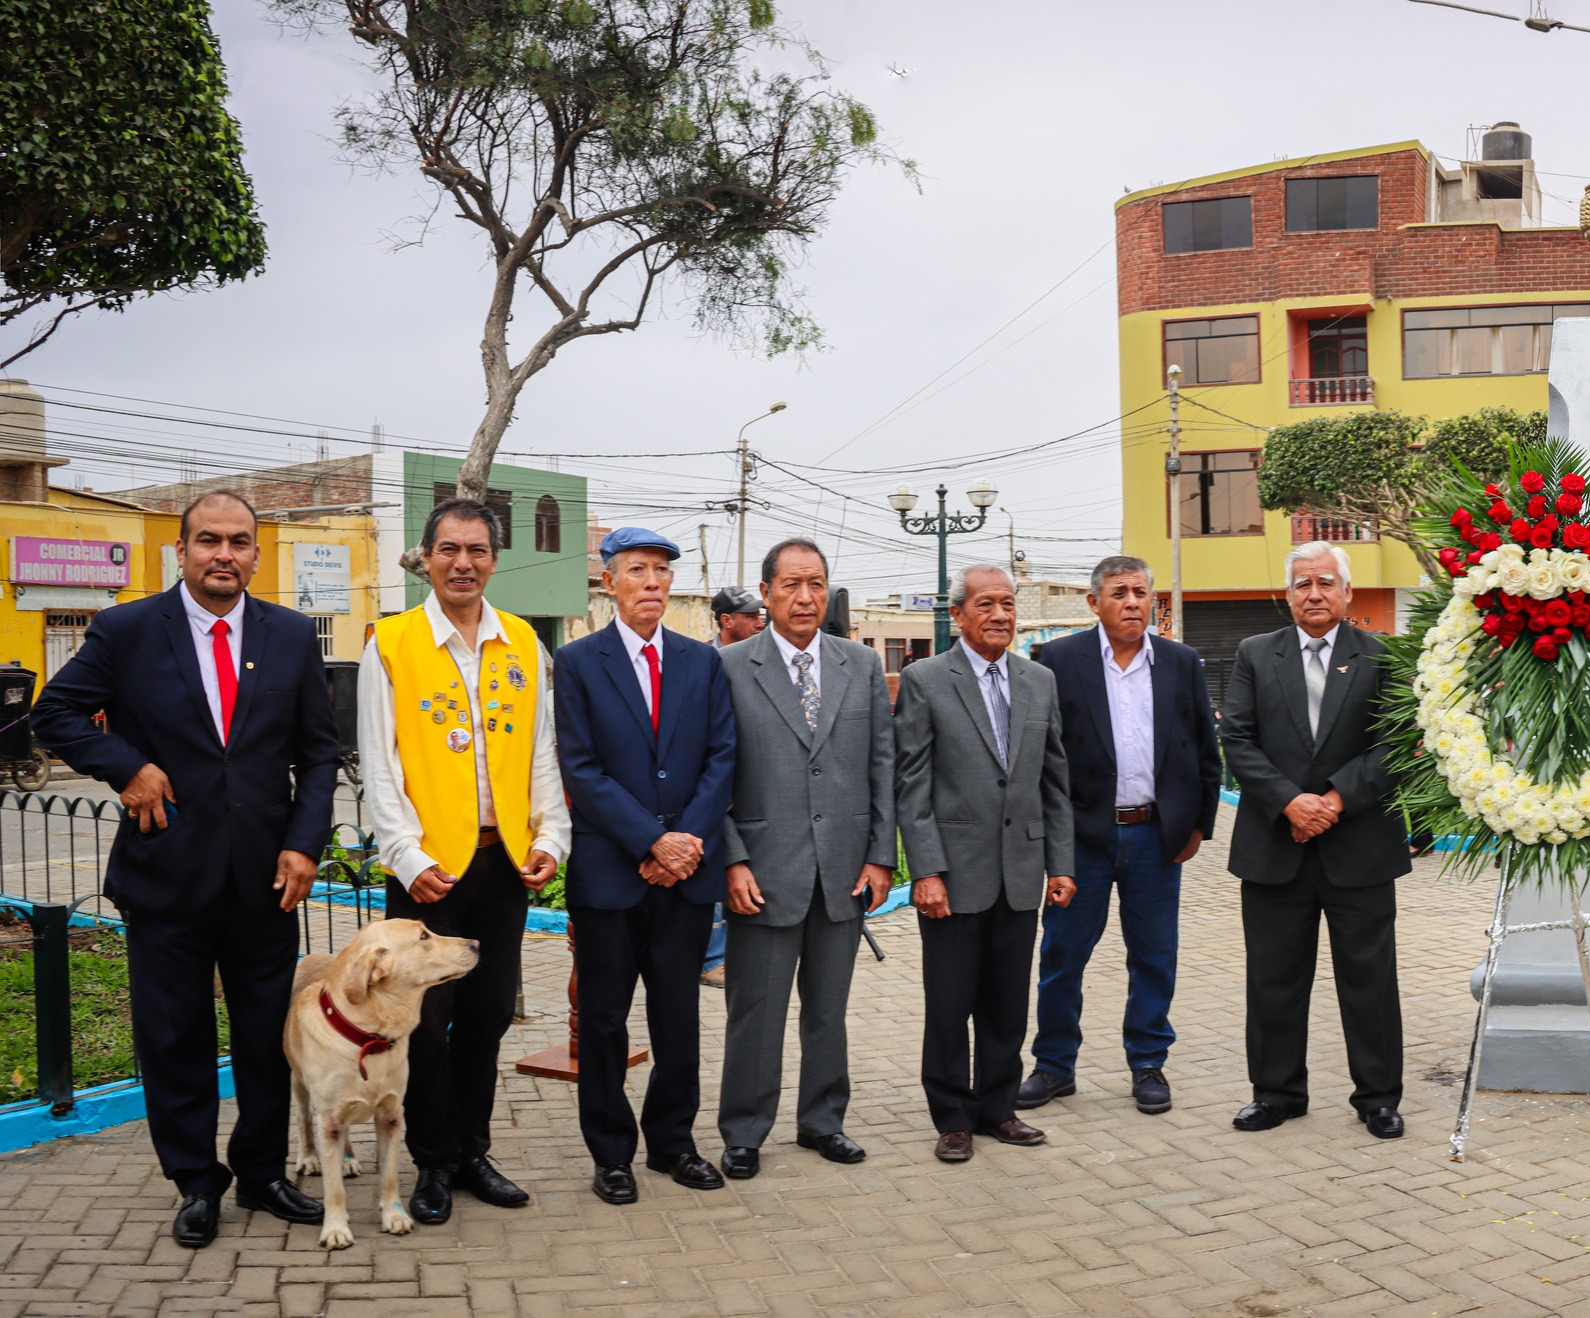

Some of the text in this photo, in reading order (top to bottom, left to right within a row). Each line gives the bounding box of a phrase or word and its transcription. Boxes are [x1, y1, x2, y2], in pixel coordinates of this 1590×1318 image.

[40, 543, 107, 562] COMERCIAL
[112, 548, 125, 561] JR
[19, 562, 127, 583] JHONNY RODRIGUEZ
